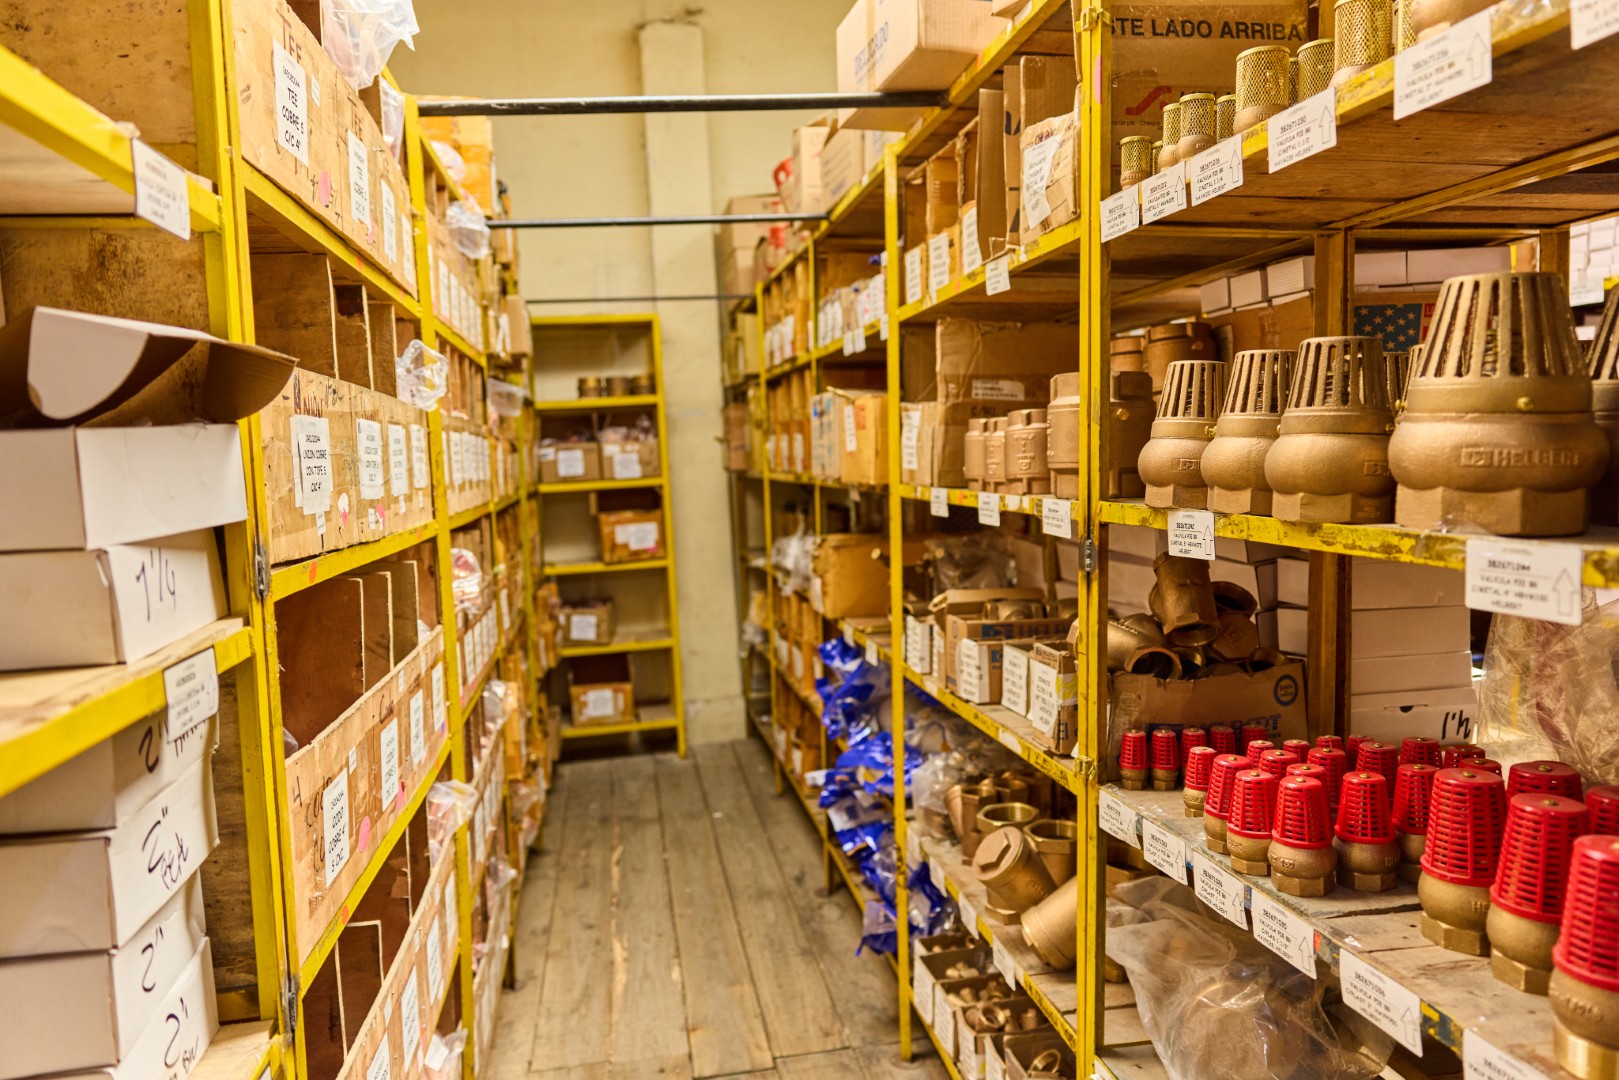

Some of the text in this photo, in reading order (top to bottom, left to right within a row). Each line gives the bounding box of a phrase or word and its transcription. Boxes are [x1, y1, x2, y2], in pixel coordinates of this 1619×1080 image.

[1151, 19, 1213, 39] LADO
[1219, 21, 1303, 41] ARRIBA
[287, 85, 297, 108] TEE
[281, 102, 299, 131] COBRE
[1276, 133, 1294, 147] VALVULA
[1197, 172, 1211, 184] VALVULA
[1480, 575, 1510, 585] VALVULA
[1259, 917, 1276, 934] VALVULA
[1349, 981, 1371, 1001] VALVULA
